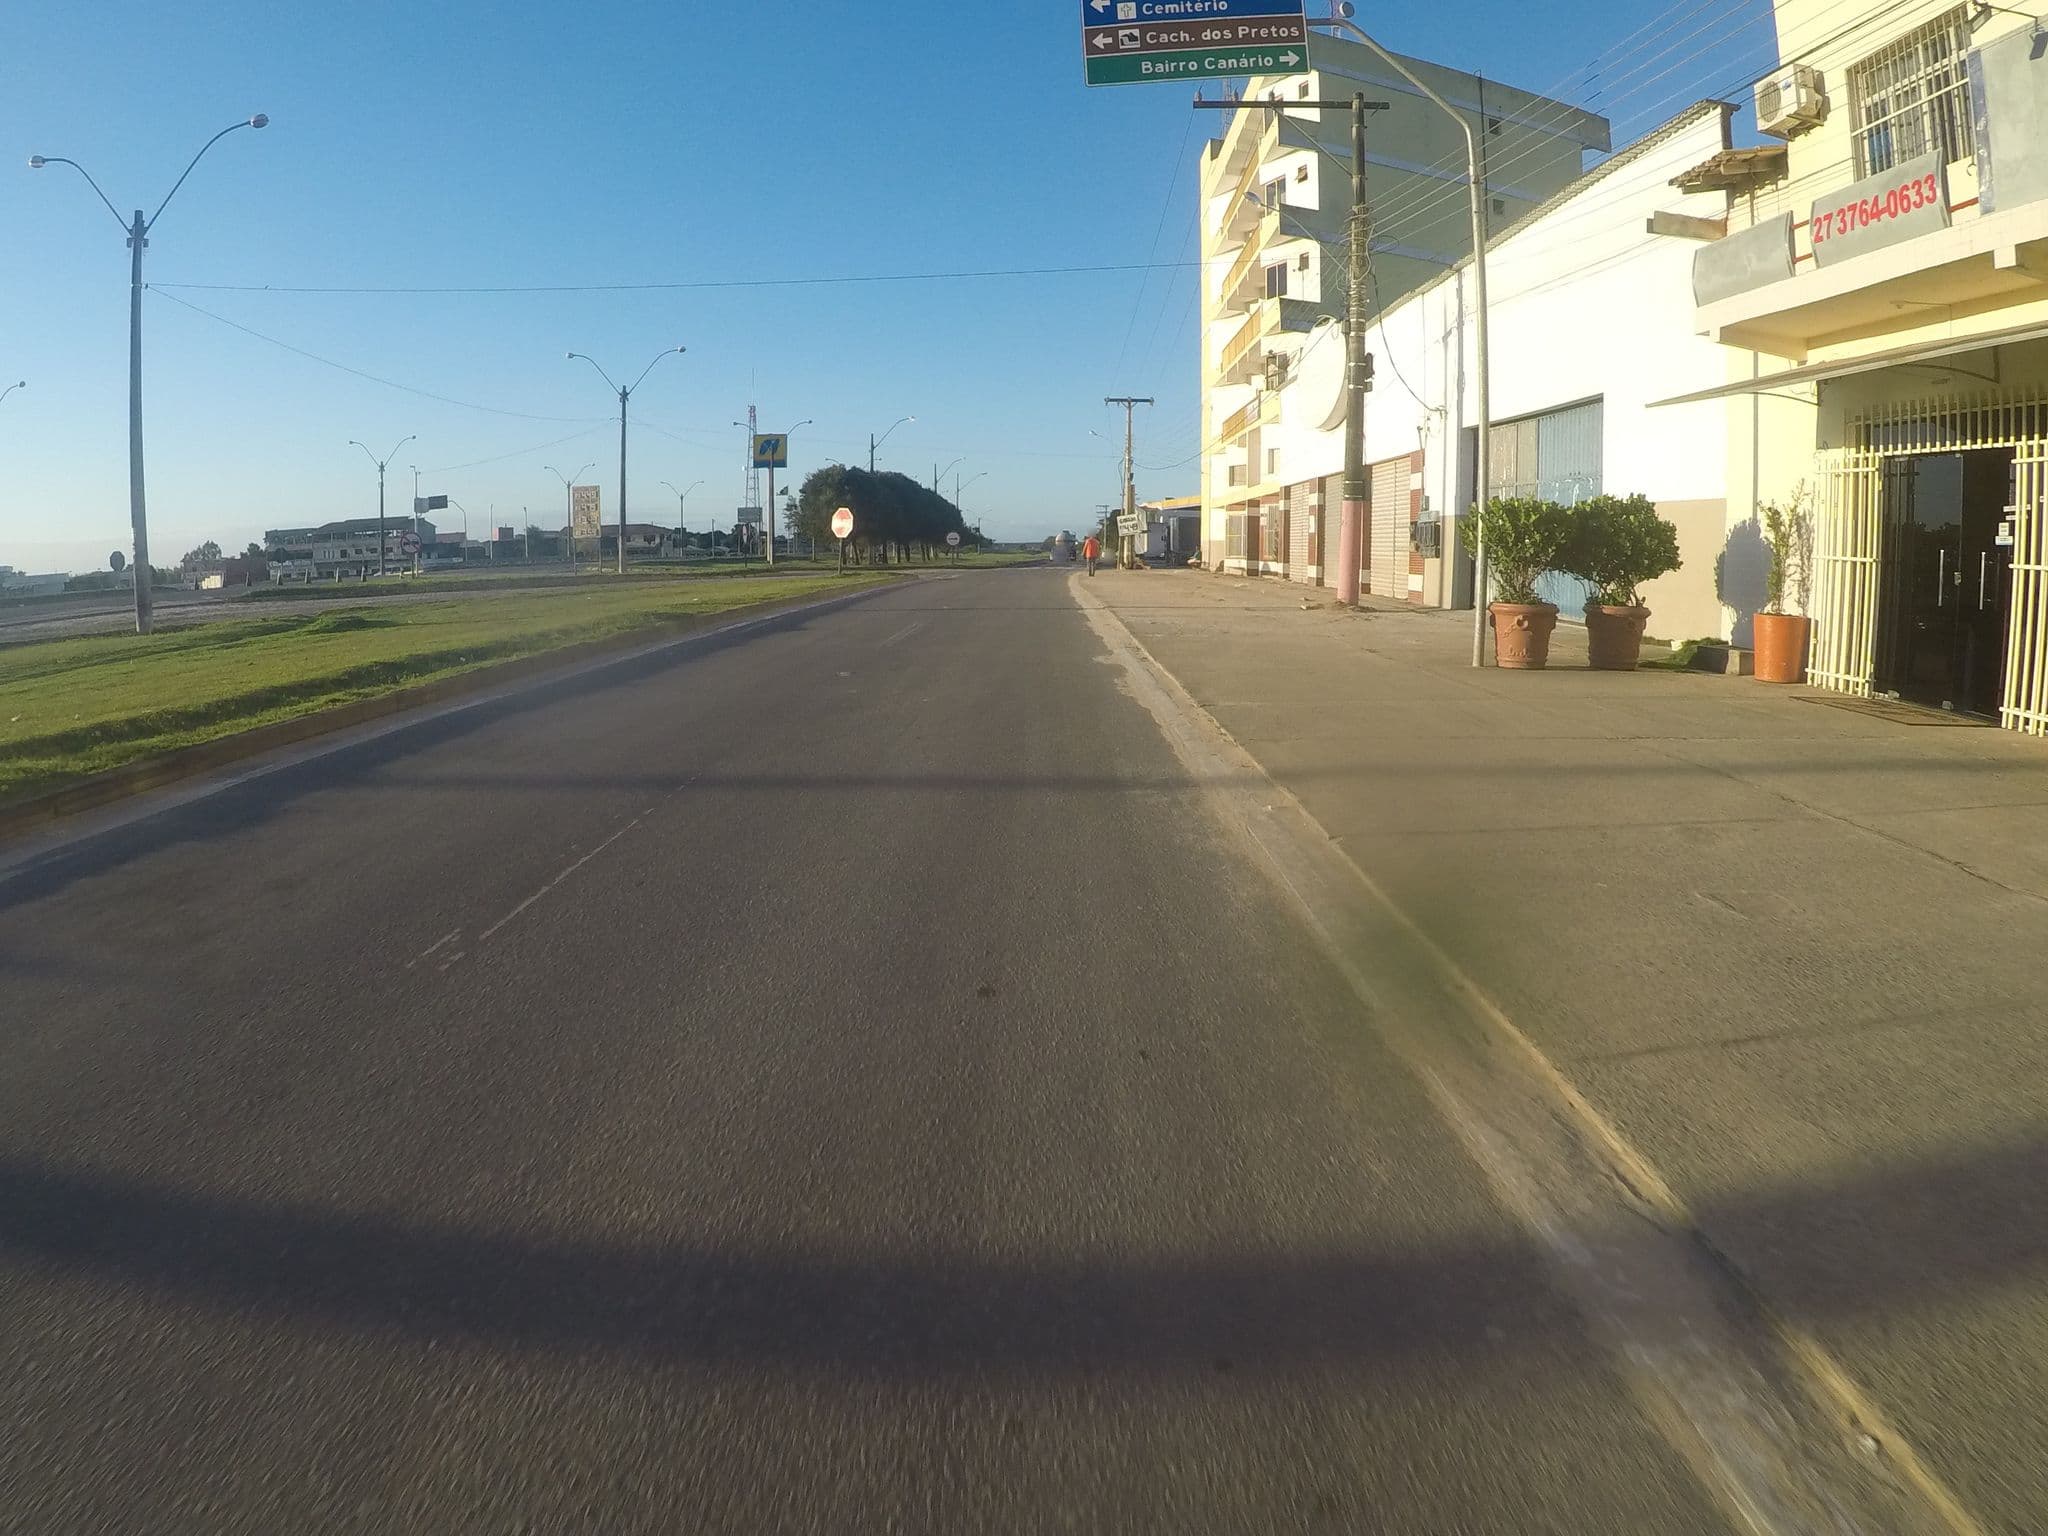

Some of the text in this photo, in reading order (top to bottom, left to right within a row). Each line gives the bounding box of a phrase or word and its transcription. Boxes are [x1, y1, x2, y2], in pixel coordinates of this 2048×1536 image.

[1142, 0, 1228, 15] Cemitério
[1146, 24, 1300, 44] Cach. dos Pretos
[1141, 53, 1274, 74] Bairro Canário
[1813, 173, 1938, 244] 27 3764-0633
